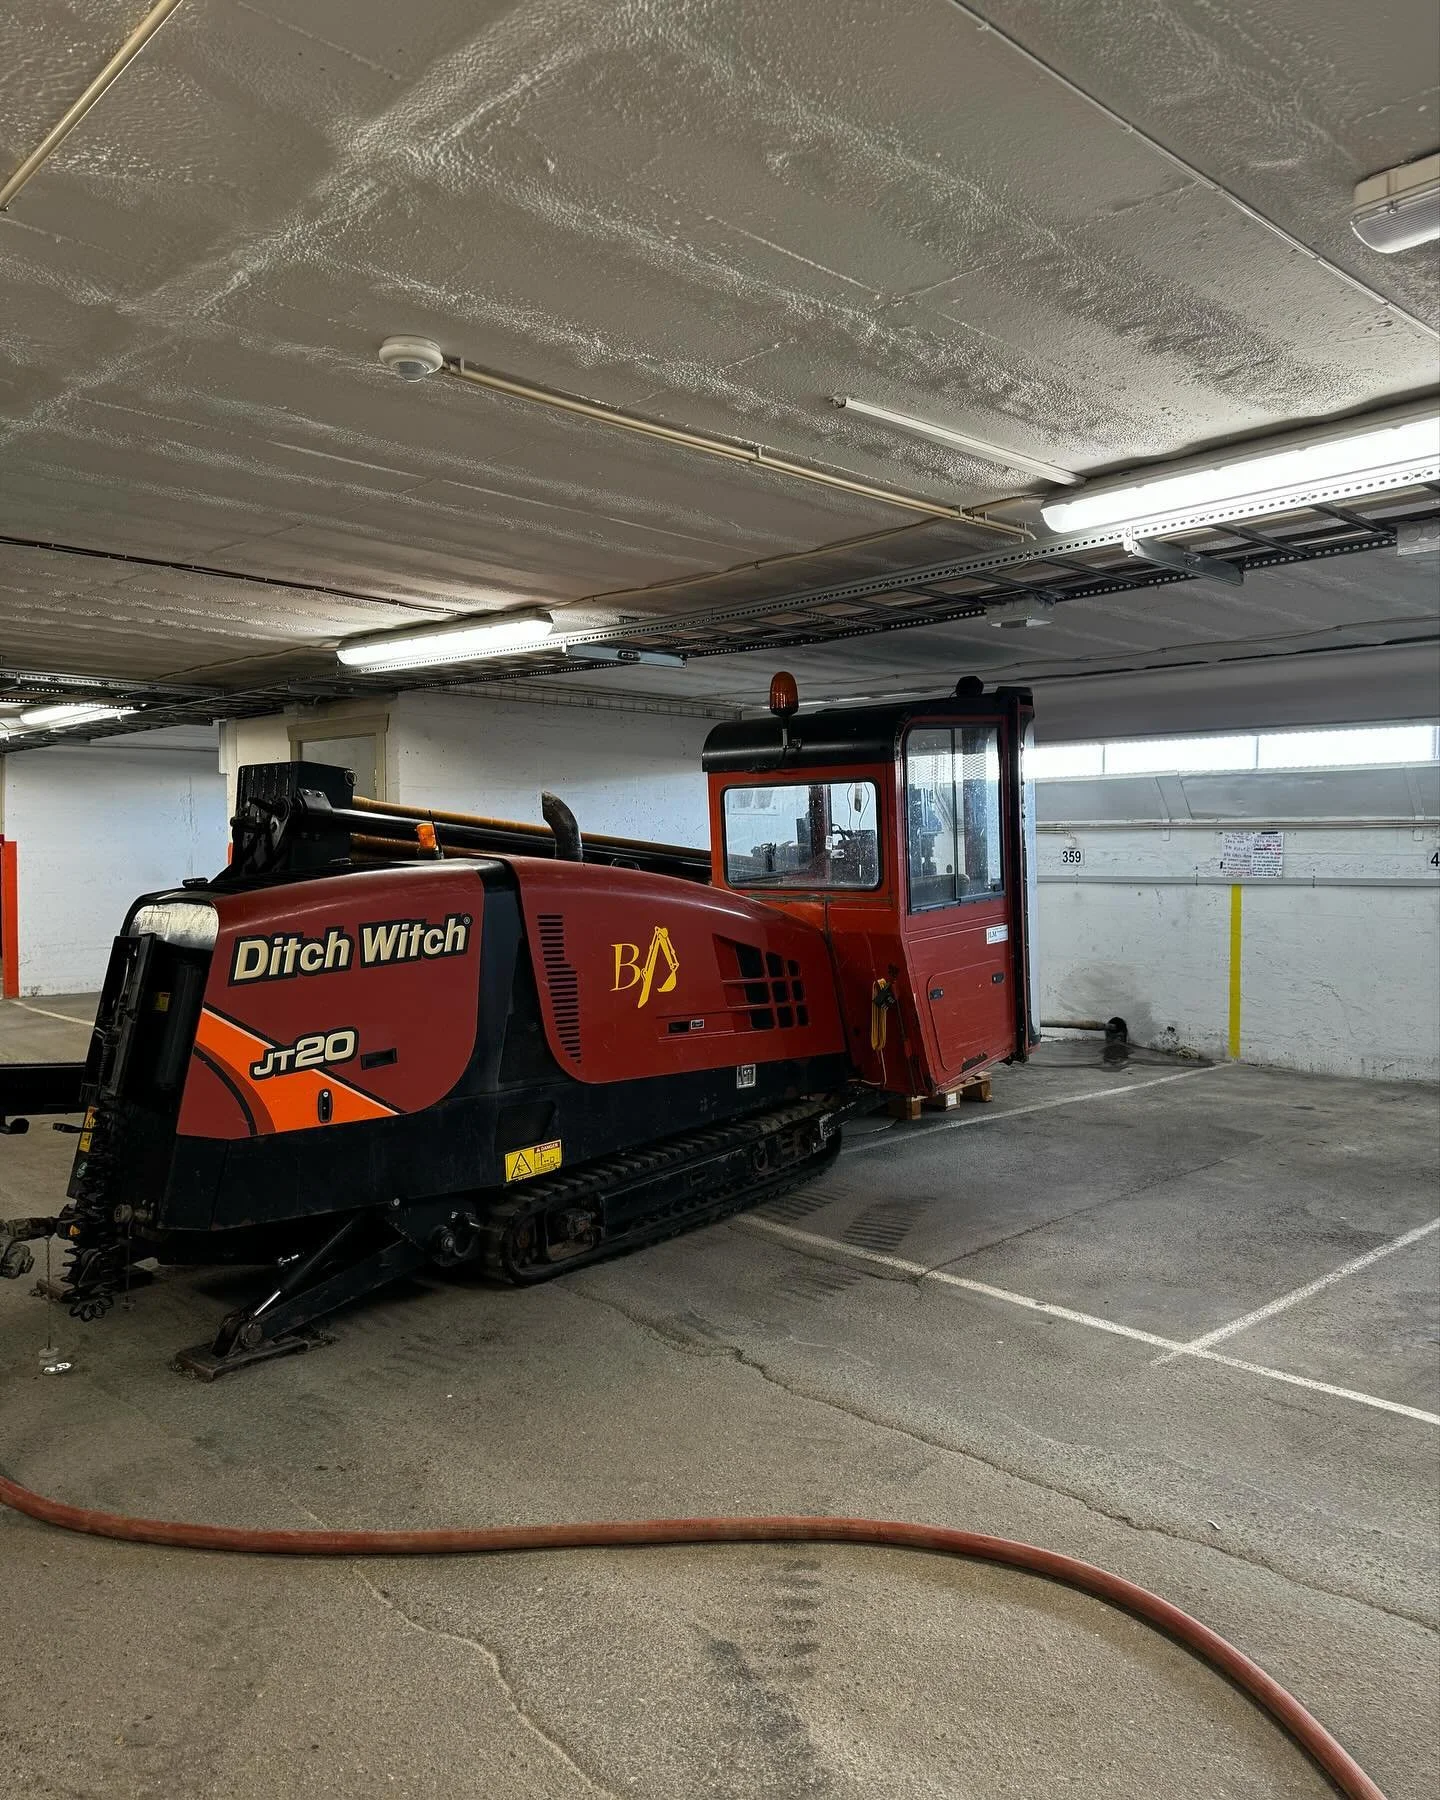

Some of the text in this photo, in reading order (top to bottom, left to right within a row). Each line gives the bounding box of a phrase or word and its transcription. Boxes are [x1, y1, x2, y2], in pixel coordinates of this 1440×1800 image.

[1062, 850, 1081, 863] 359
[233, 931, 350, 981] Ditch
[253, 1030, 356, 1076] JT20
